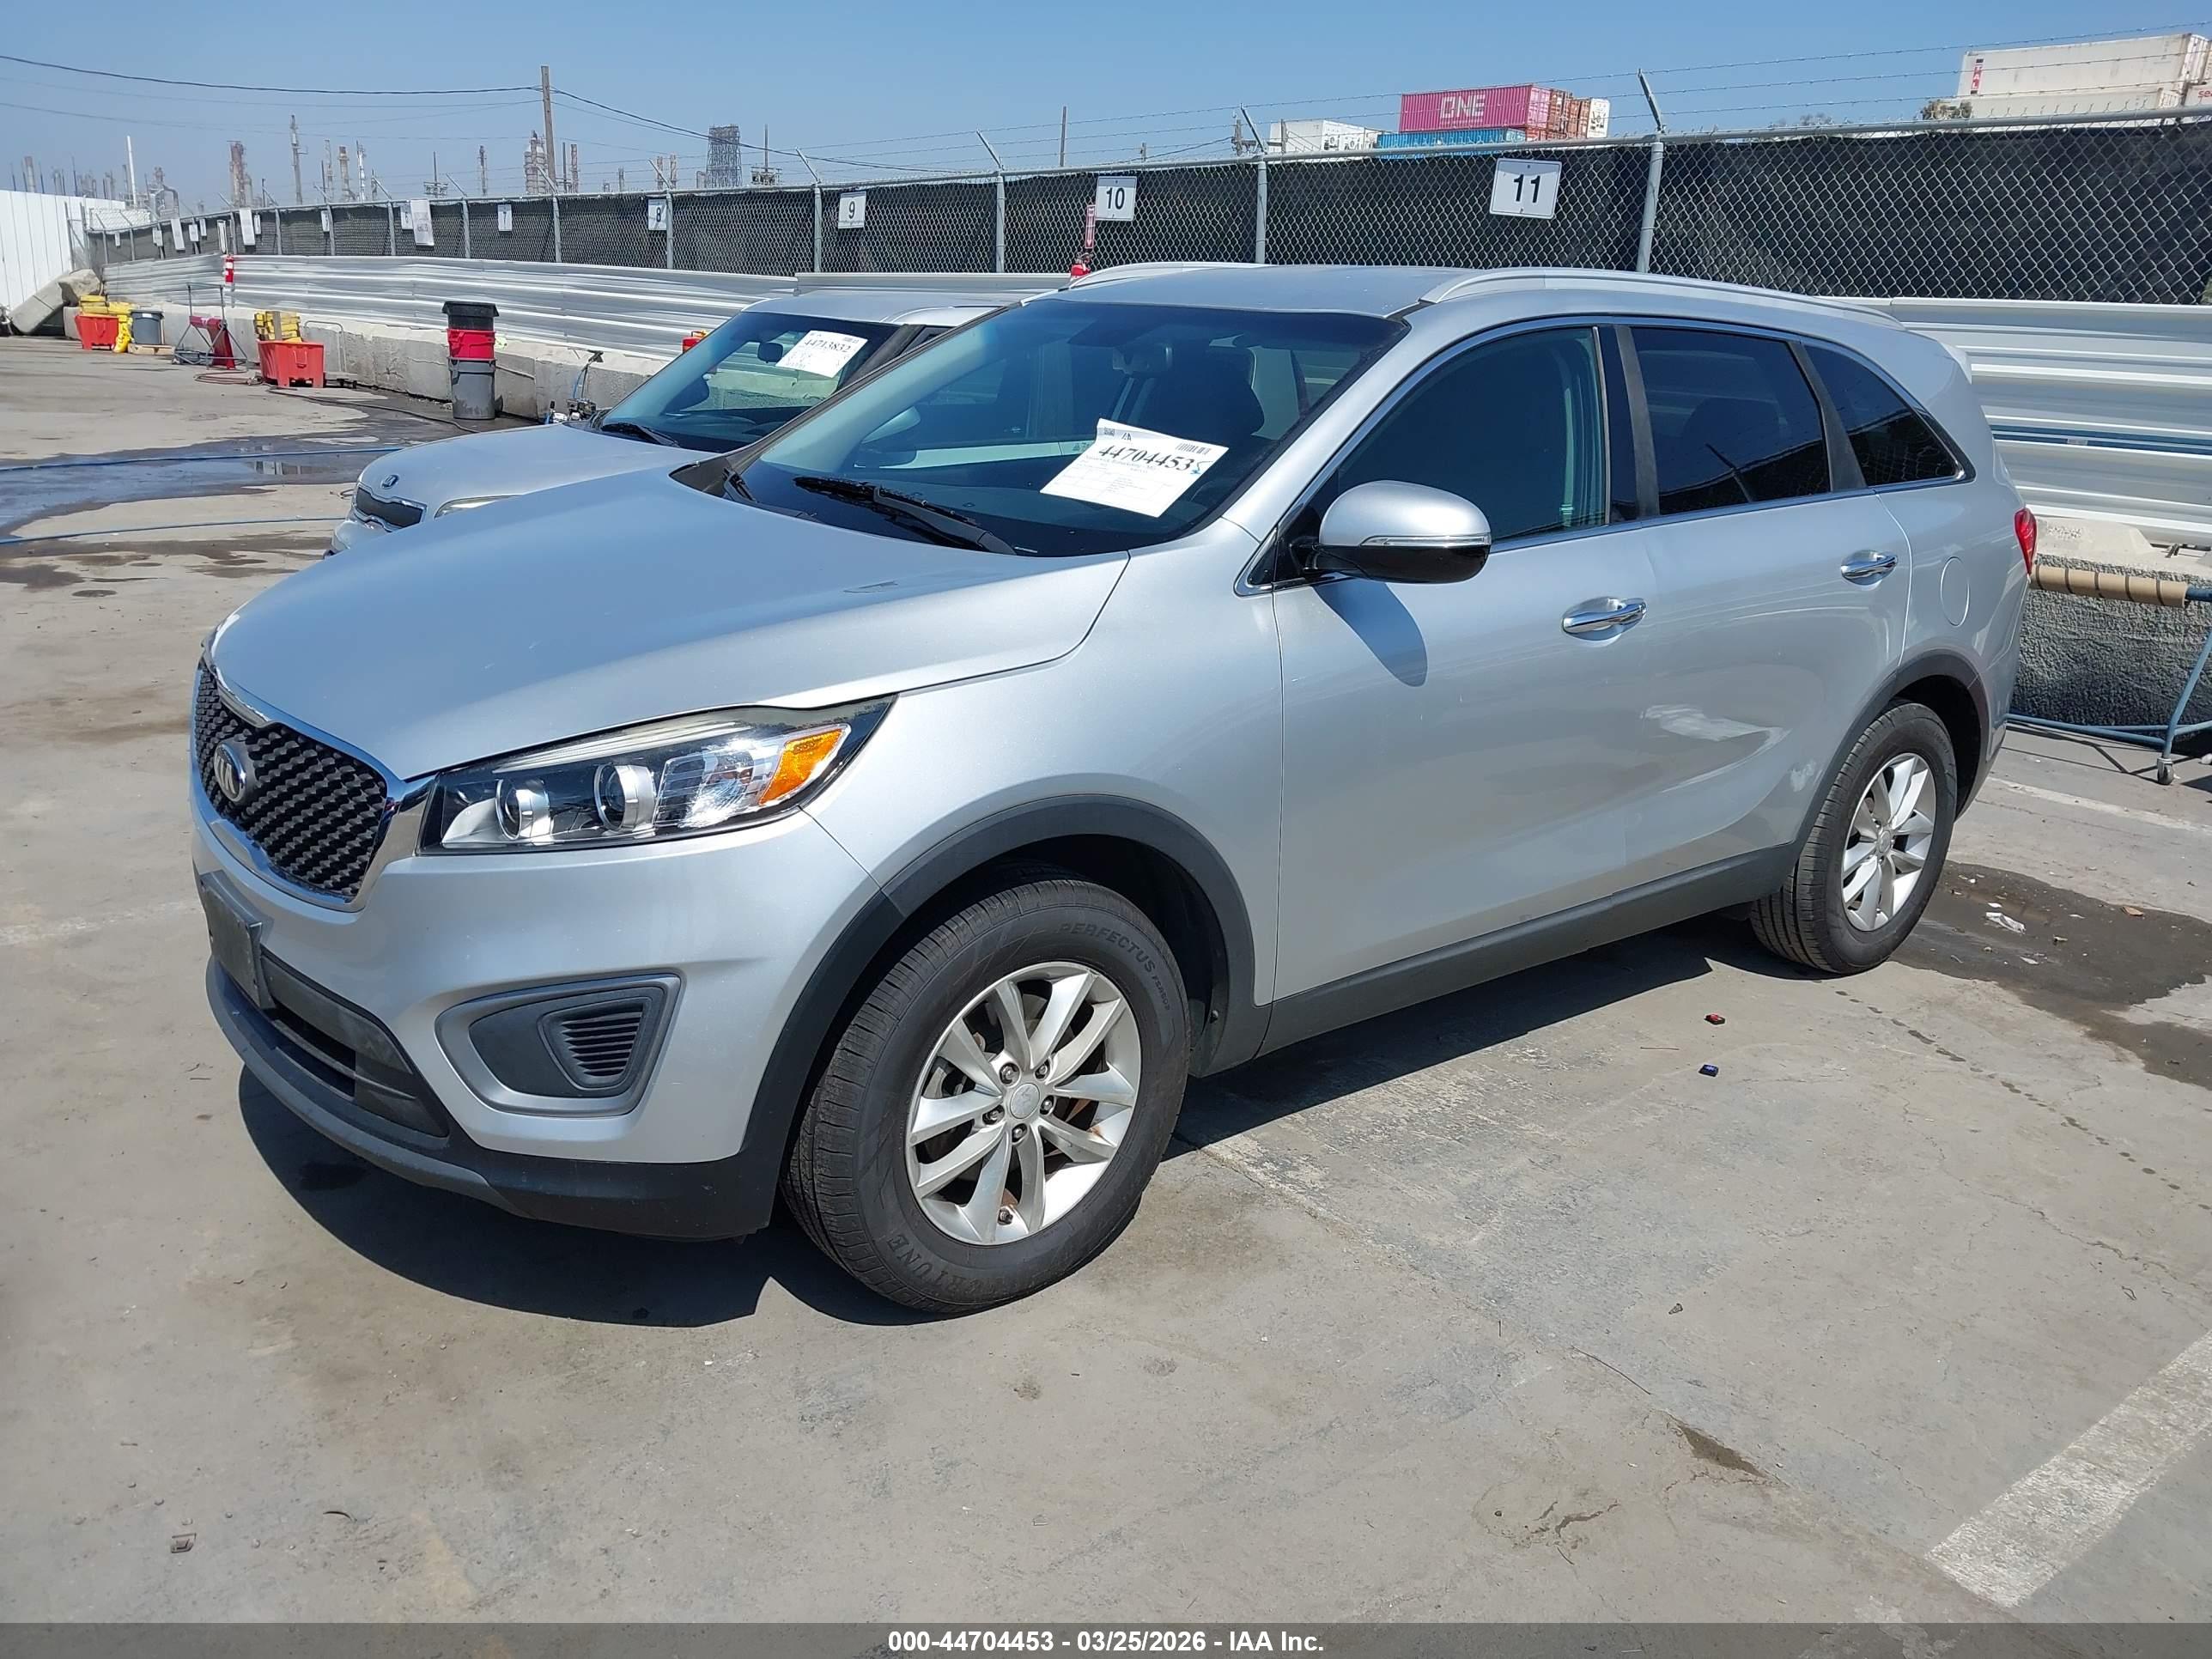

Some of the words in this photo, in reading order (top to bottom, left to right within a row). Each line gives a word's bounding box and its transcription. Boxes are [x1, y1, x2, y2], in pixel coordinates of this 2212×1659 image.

[2198, 89, 2212, 98] se
[1440, 94, 1486, 118] ONE
[1106, 187, 1125, 210] 10
[1513, 173, 1540, 204] 11
[656, 206, 662, 222] 8
[848, 200, 856, 220] 9
[1098, 445, 1195, 471] 44704453
[1057, 921, 1156, 973] PERFECTUS
